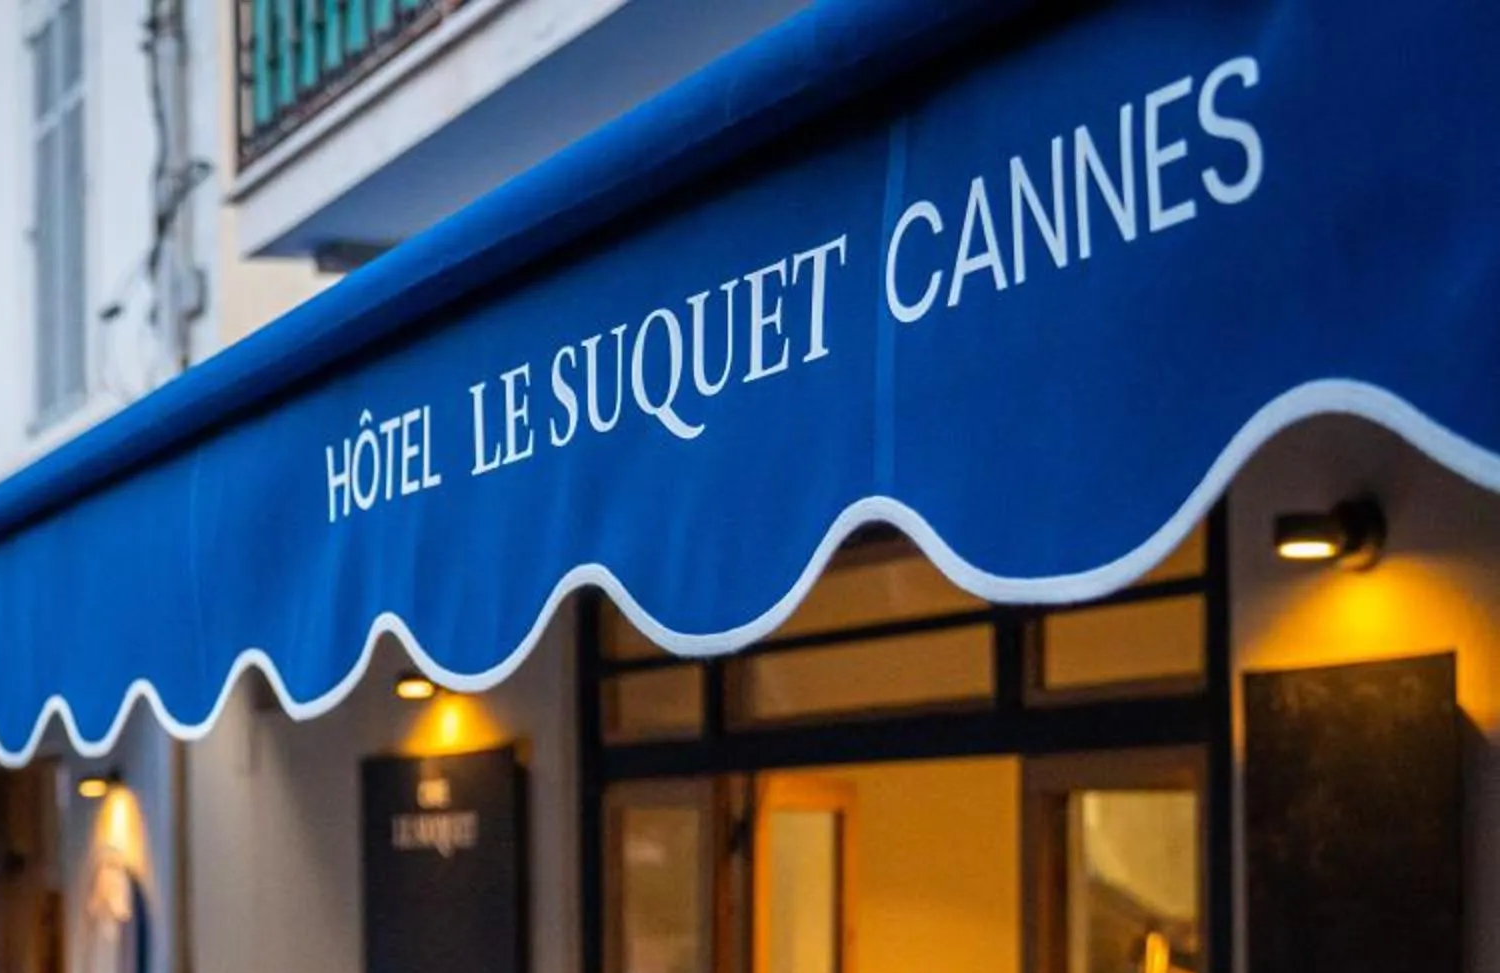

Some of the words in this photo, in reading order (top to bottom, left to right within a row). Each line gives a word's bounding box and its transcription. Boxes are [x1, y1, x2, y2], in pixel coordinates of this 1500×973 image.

[325, 406, 442, 522] HÔTEL
[468, 363, 533, 476] LE
[550, 234, 846, 447] SUQUET
[885, 57, 1263, 323] CANNES
